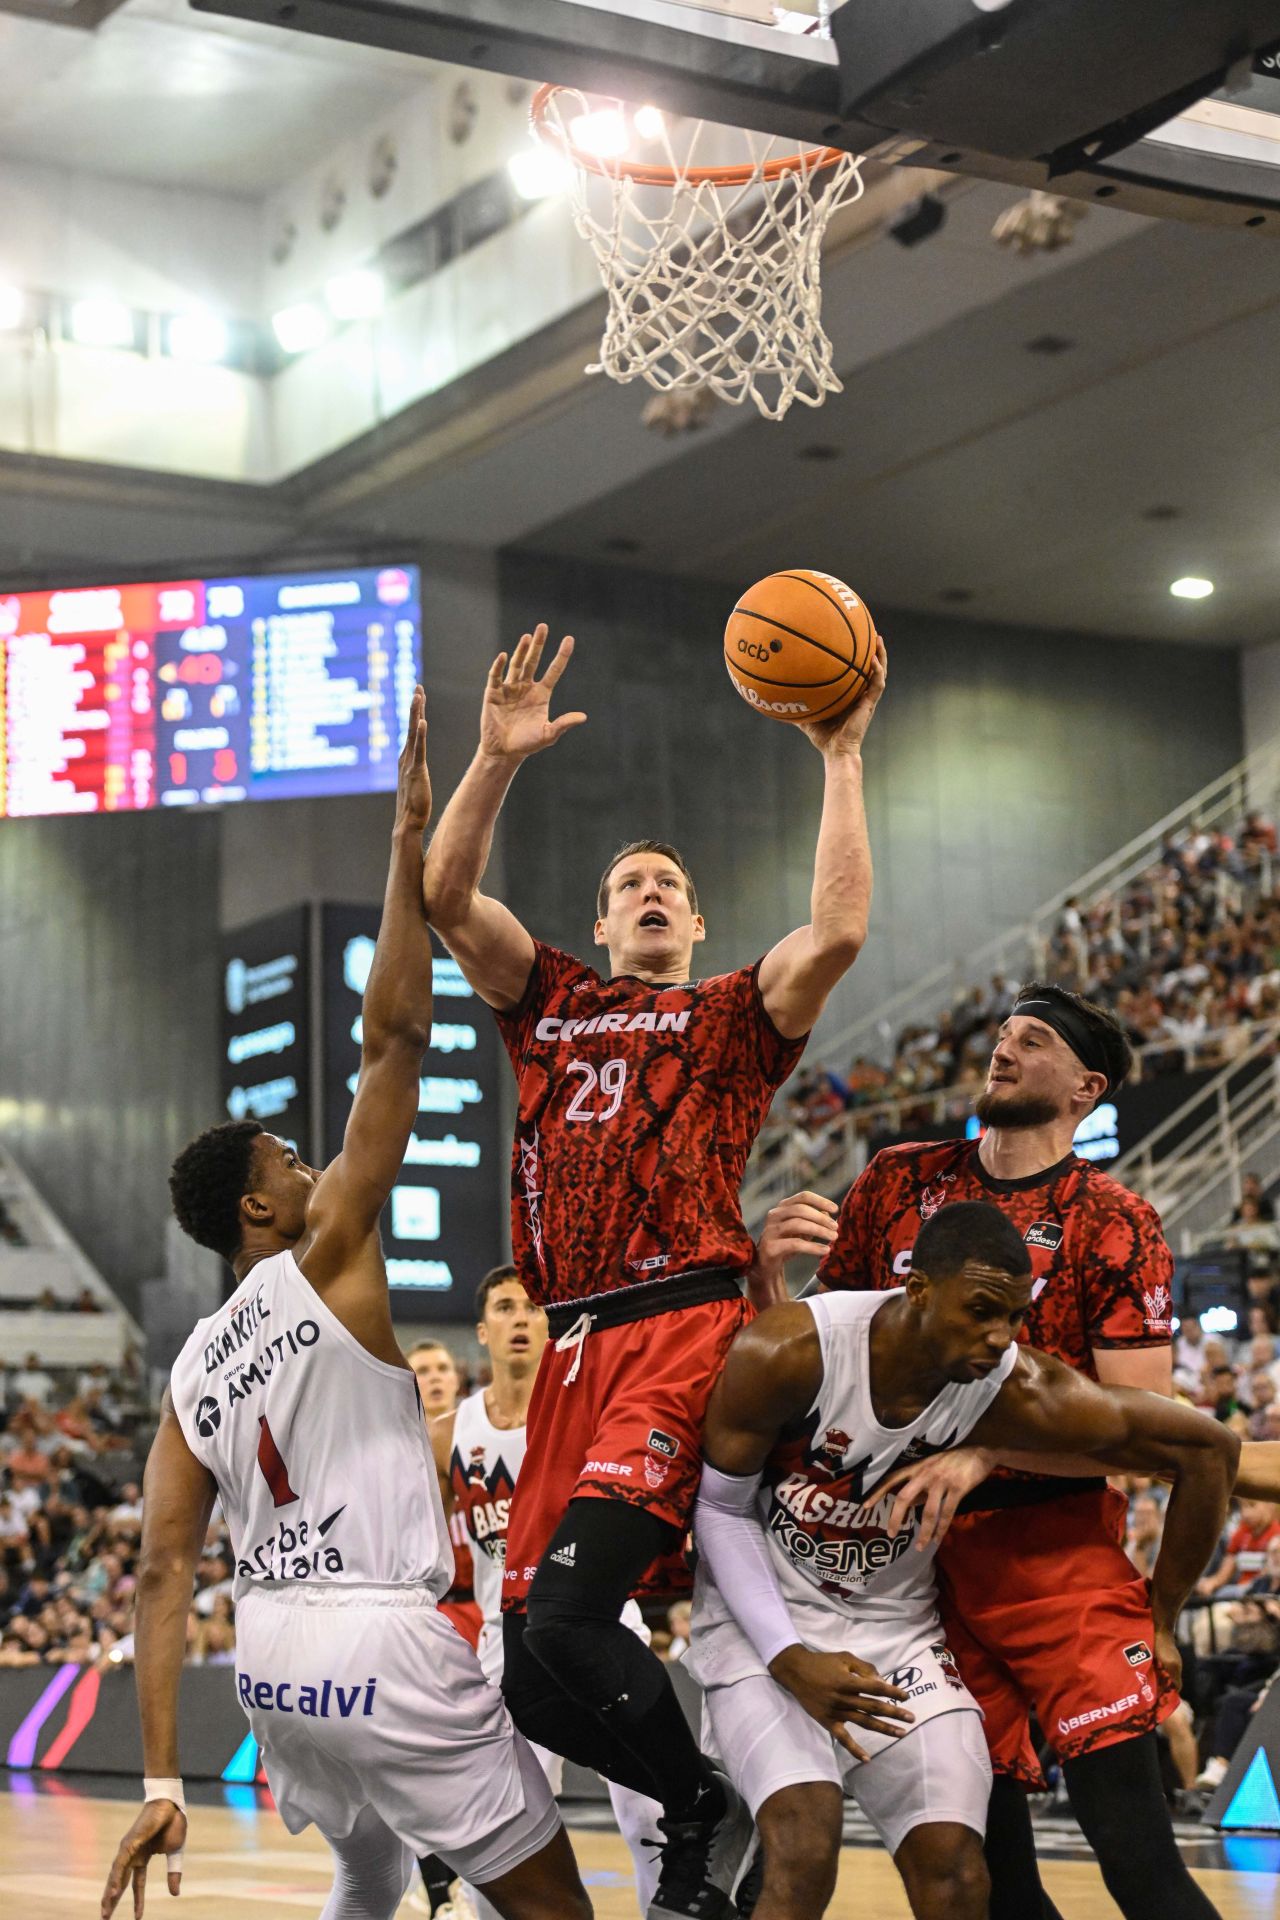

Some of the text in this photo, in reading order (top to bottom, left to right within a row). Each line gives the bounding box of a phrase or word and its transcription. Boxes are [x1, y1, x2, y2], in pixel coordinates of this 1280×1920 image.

[737, 638, 770, 662] acb
[565, 1058, 627, 1123] 29
[223, 1362, 246, 1381] GRUPO
[228, 1320, 320, 1407] AMUTIO
[651, 1437, 670, 1453] acb
[257, 1415, 300, 1508] 1
[580, 1461, 633, 1477] RNER
[550, 1553, 576, 1567] adidas
[1129, 1651, 1147, 1663] acb
[238, 1672, 377, 1718] Recalvi
[1068, 1693, 1139, 1730] BERNER
